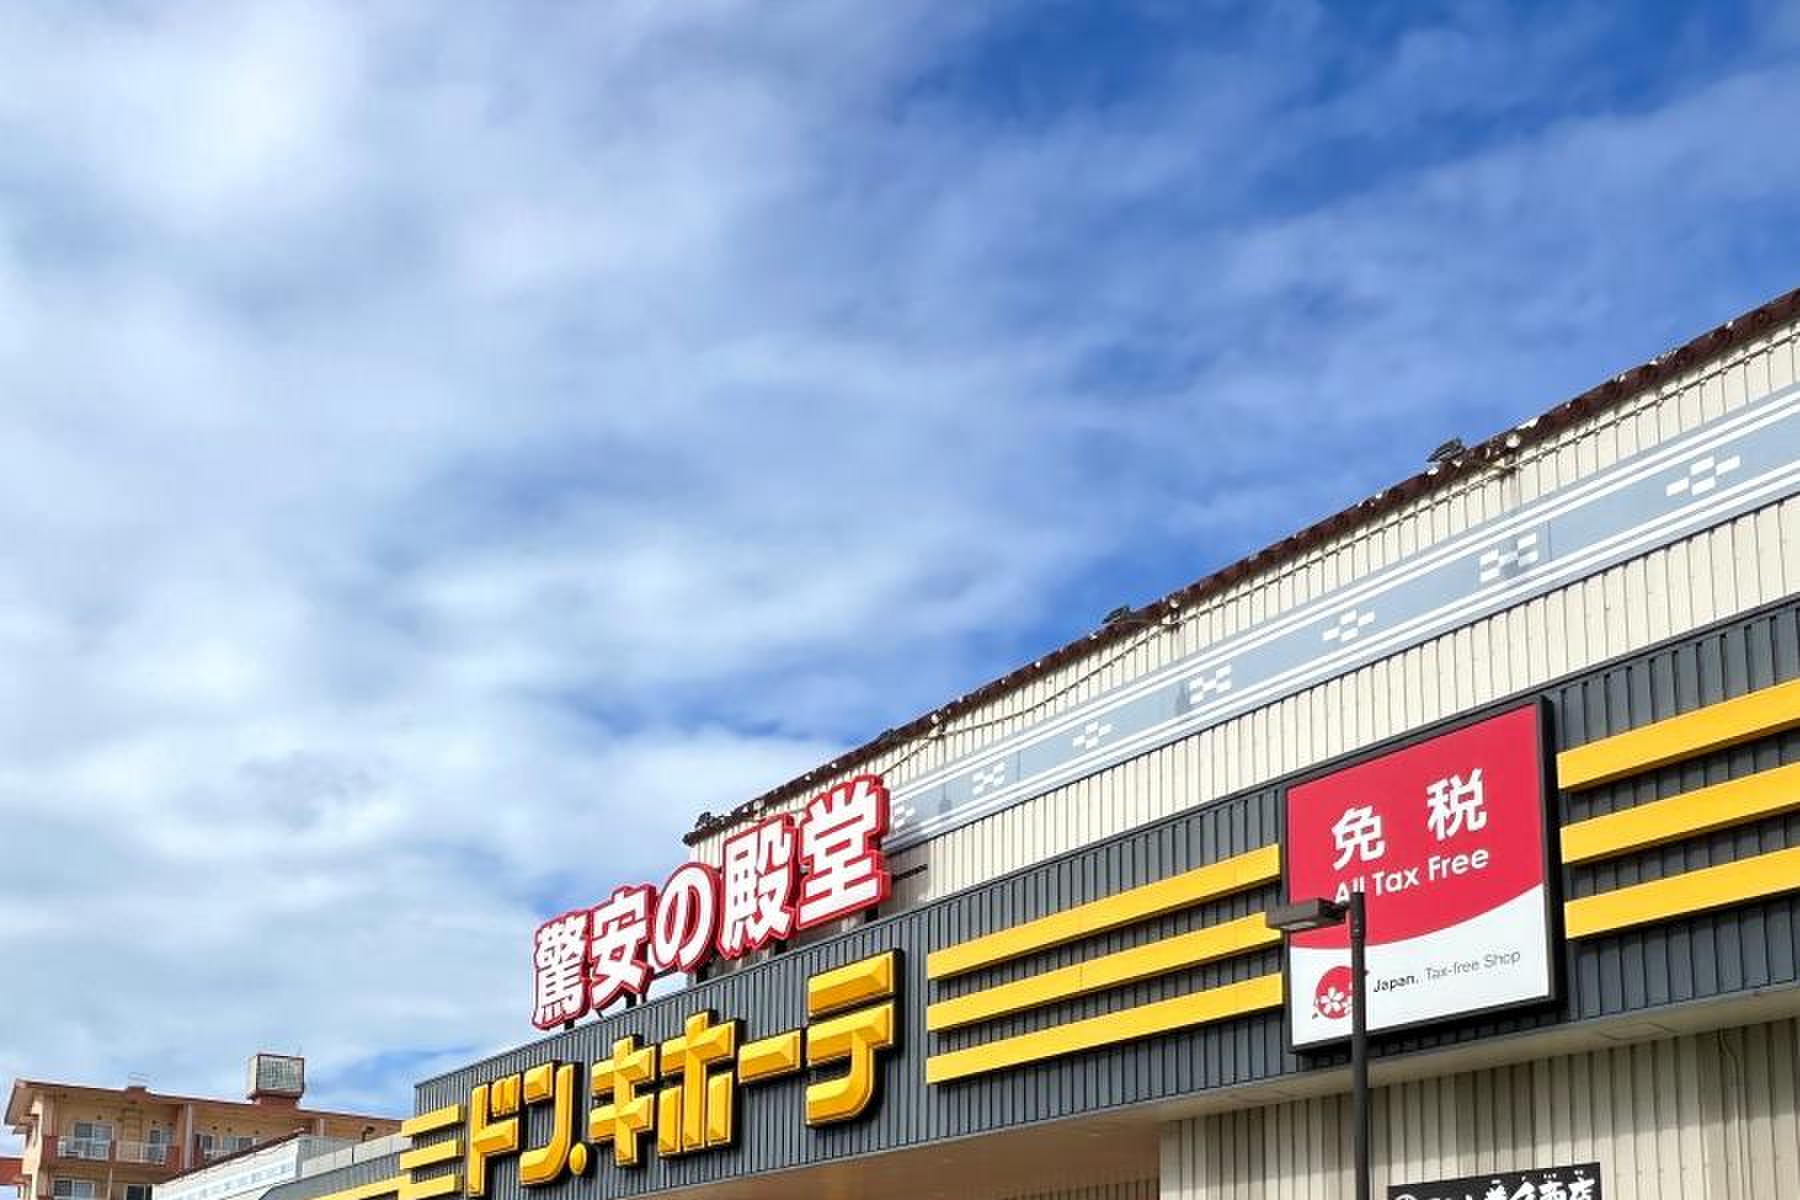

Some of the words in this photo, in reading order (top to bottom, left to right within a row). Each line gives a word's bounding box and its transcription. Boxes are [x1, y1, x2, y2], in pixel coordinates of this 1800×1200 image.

[1374, 866, 1419, 895] Tax
[1428, 847, 1490, 881] Free
[531, 774, 890, 1030] 驚安の殿堂
[1426, 959, 1480, 980] Tax-free
[1483, 950, 1521, 968] Shop
